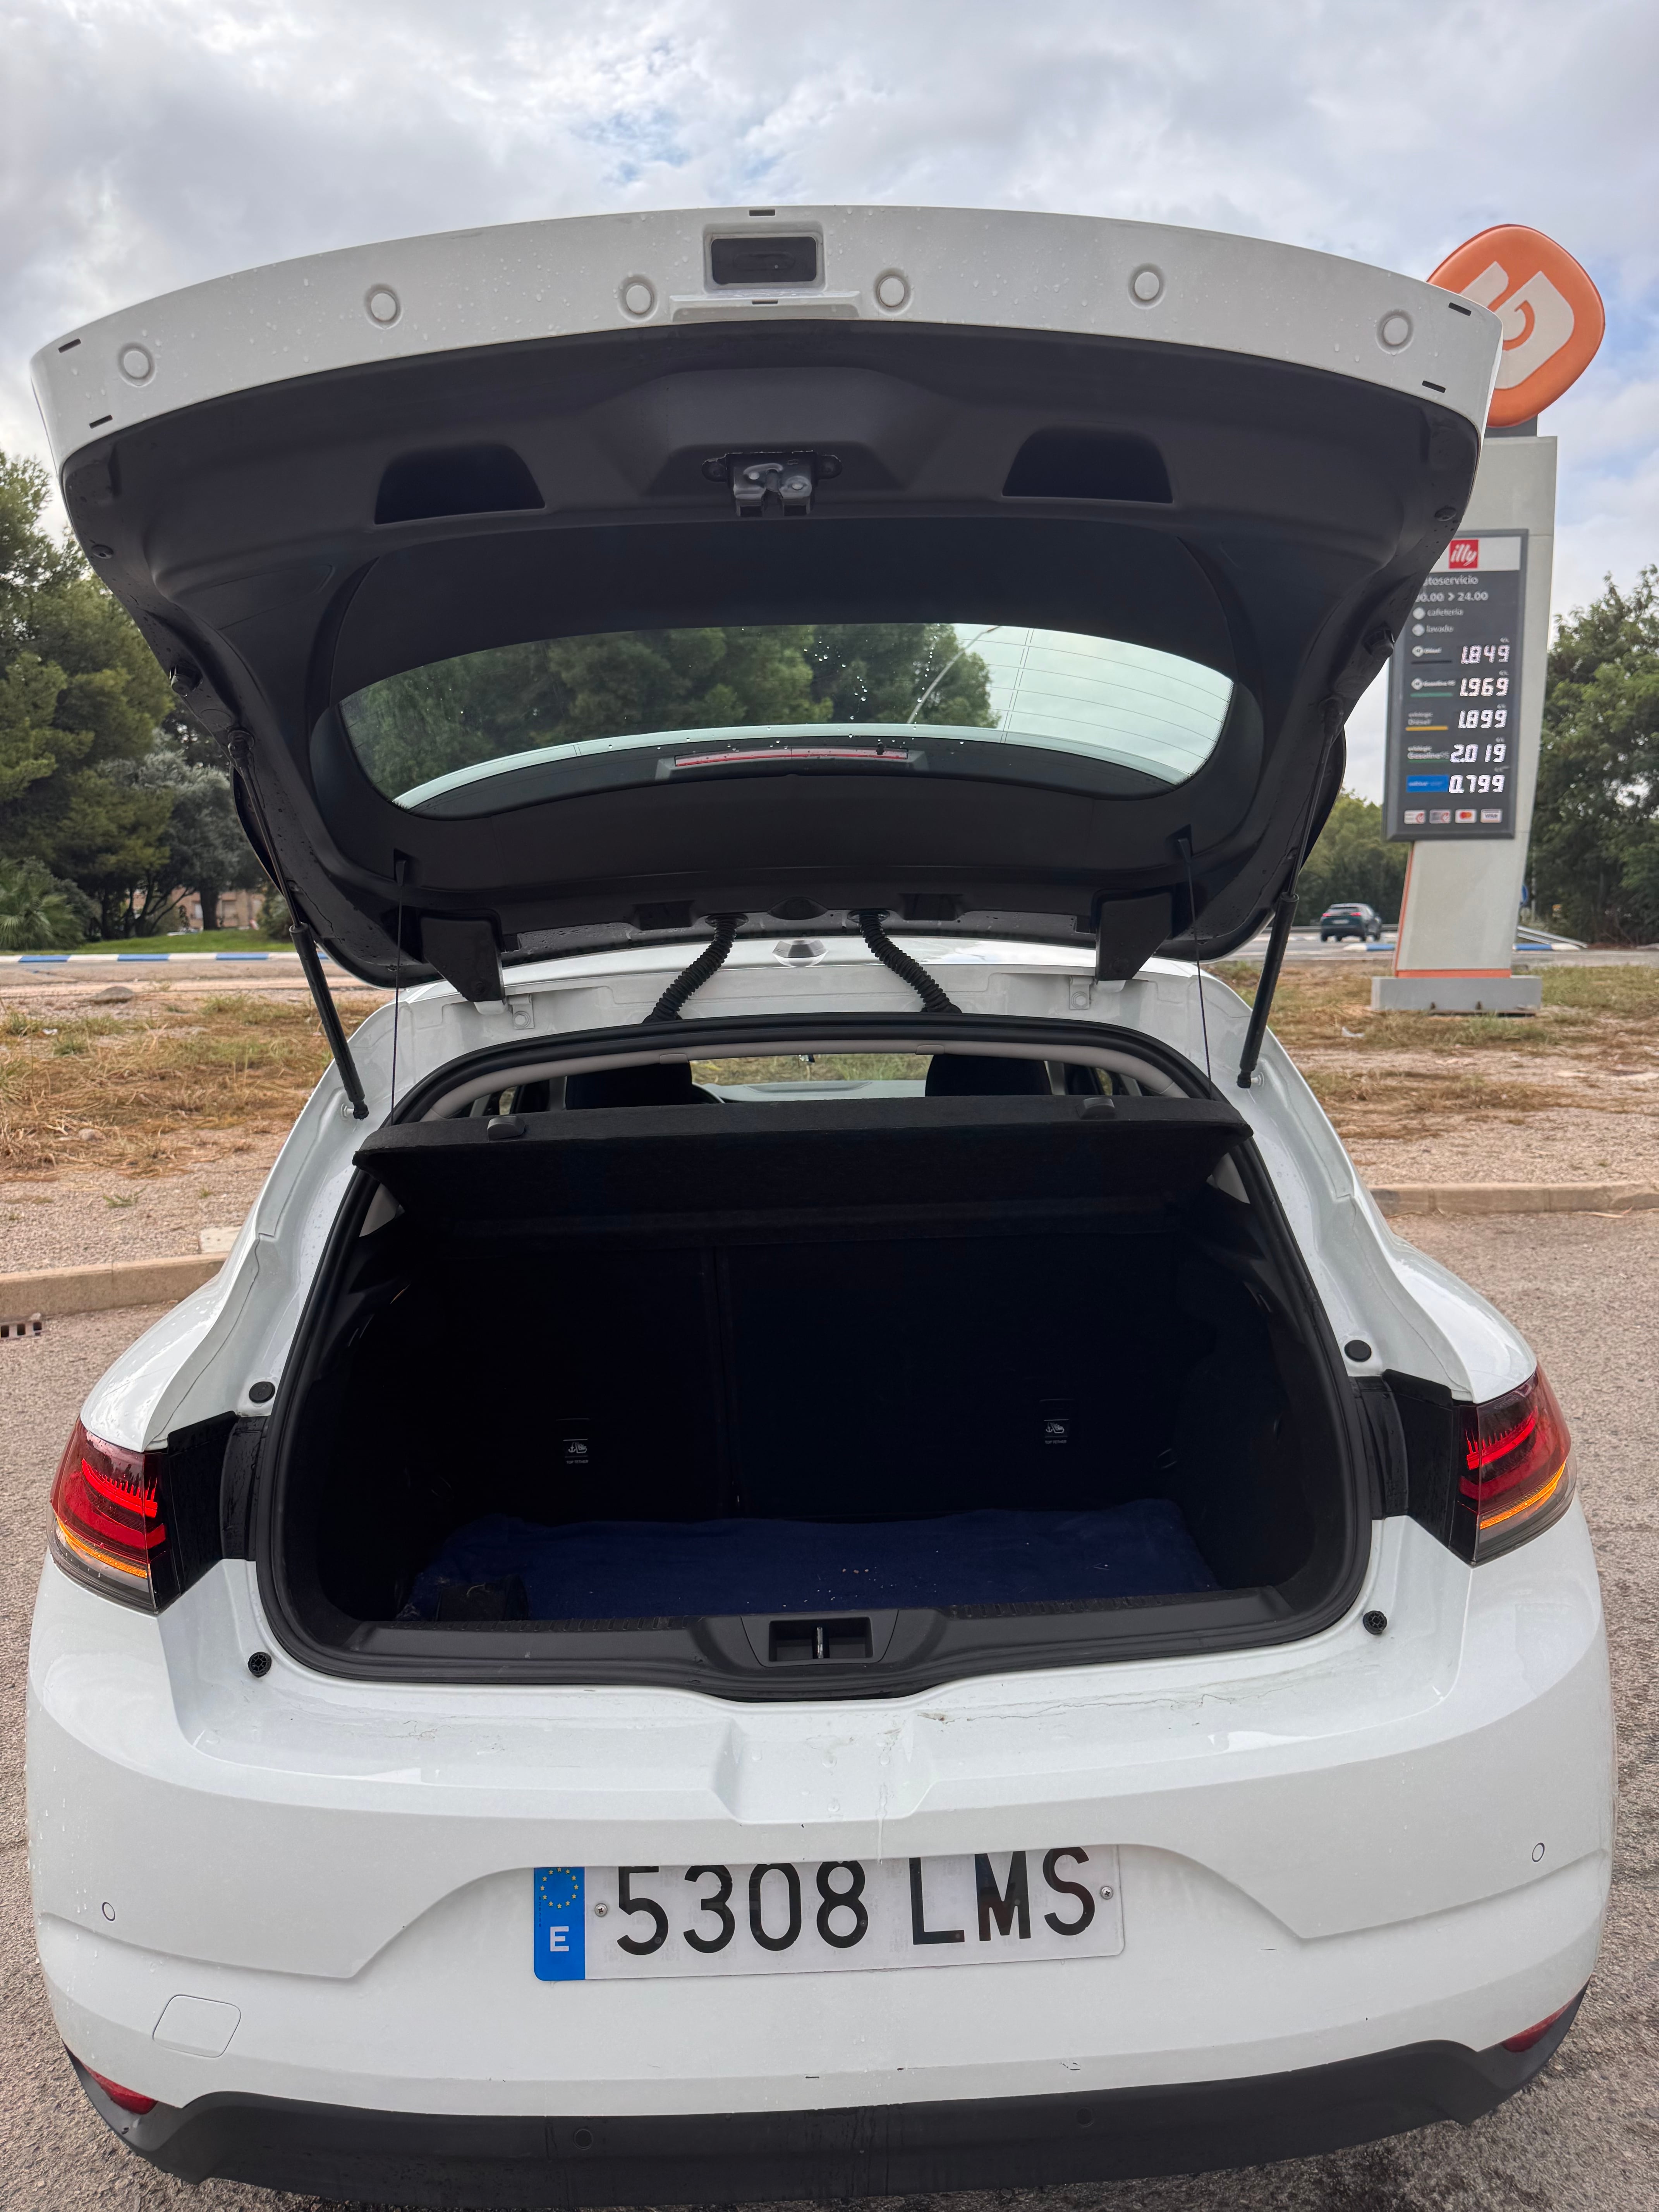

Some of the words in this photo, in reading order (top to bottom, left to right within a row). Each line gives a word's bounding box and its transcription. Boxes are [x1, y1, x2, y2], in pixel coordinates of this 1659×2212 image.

[1450, 543, 1477, 566] illy
[1457, 591, 1489, 601] 24.00
[616, 1860, 867, 1955] 5308
[908, 1844, 1096, 1946] LMS
[550, 1926, 569, 1952] E
